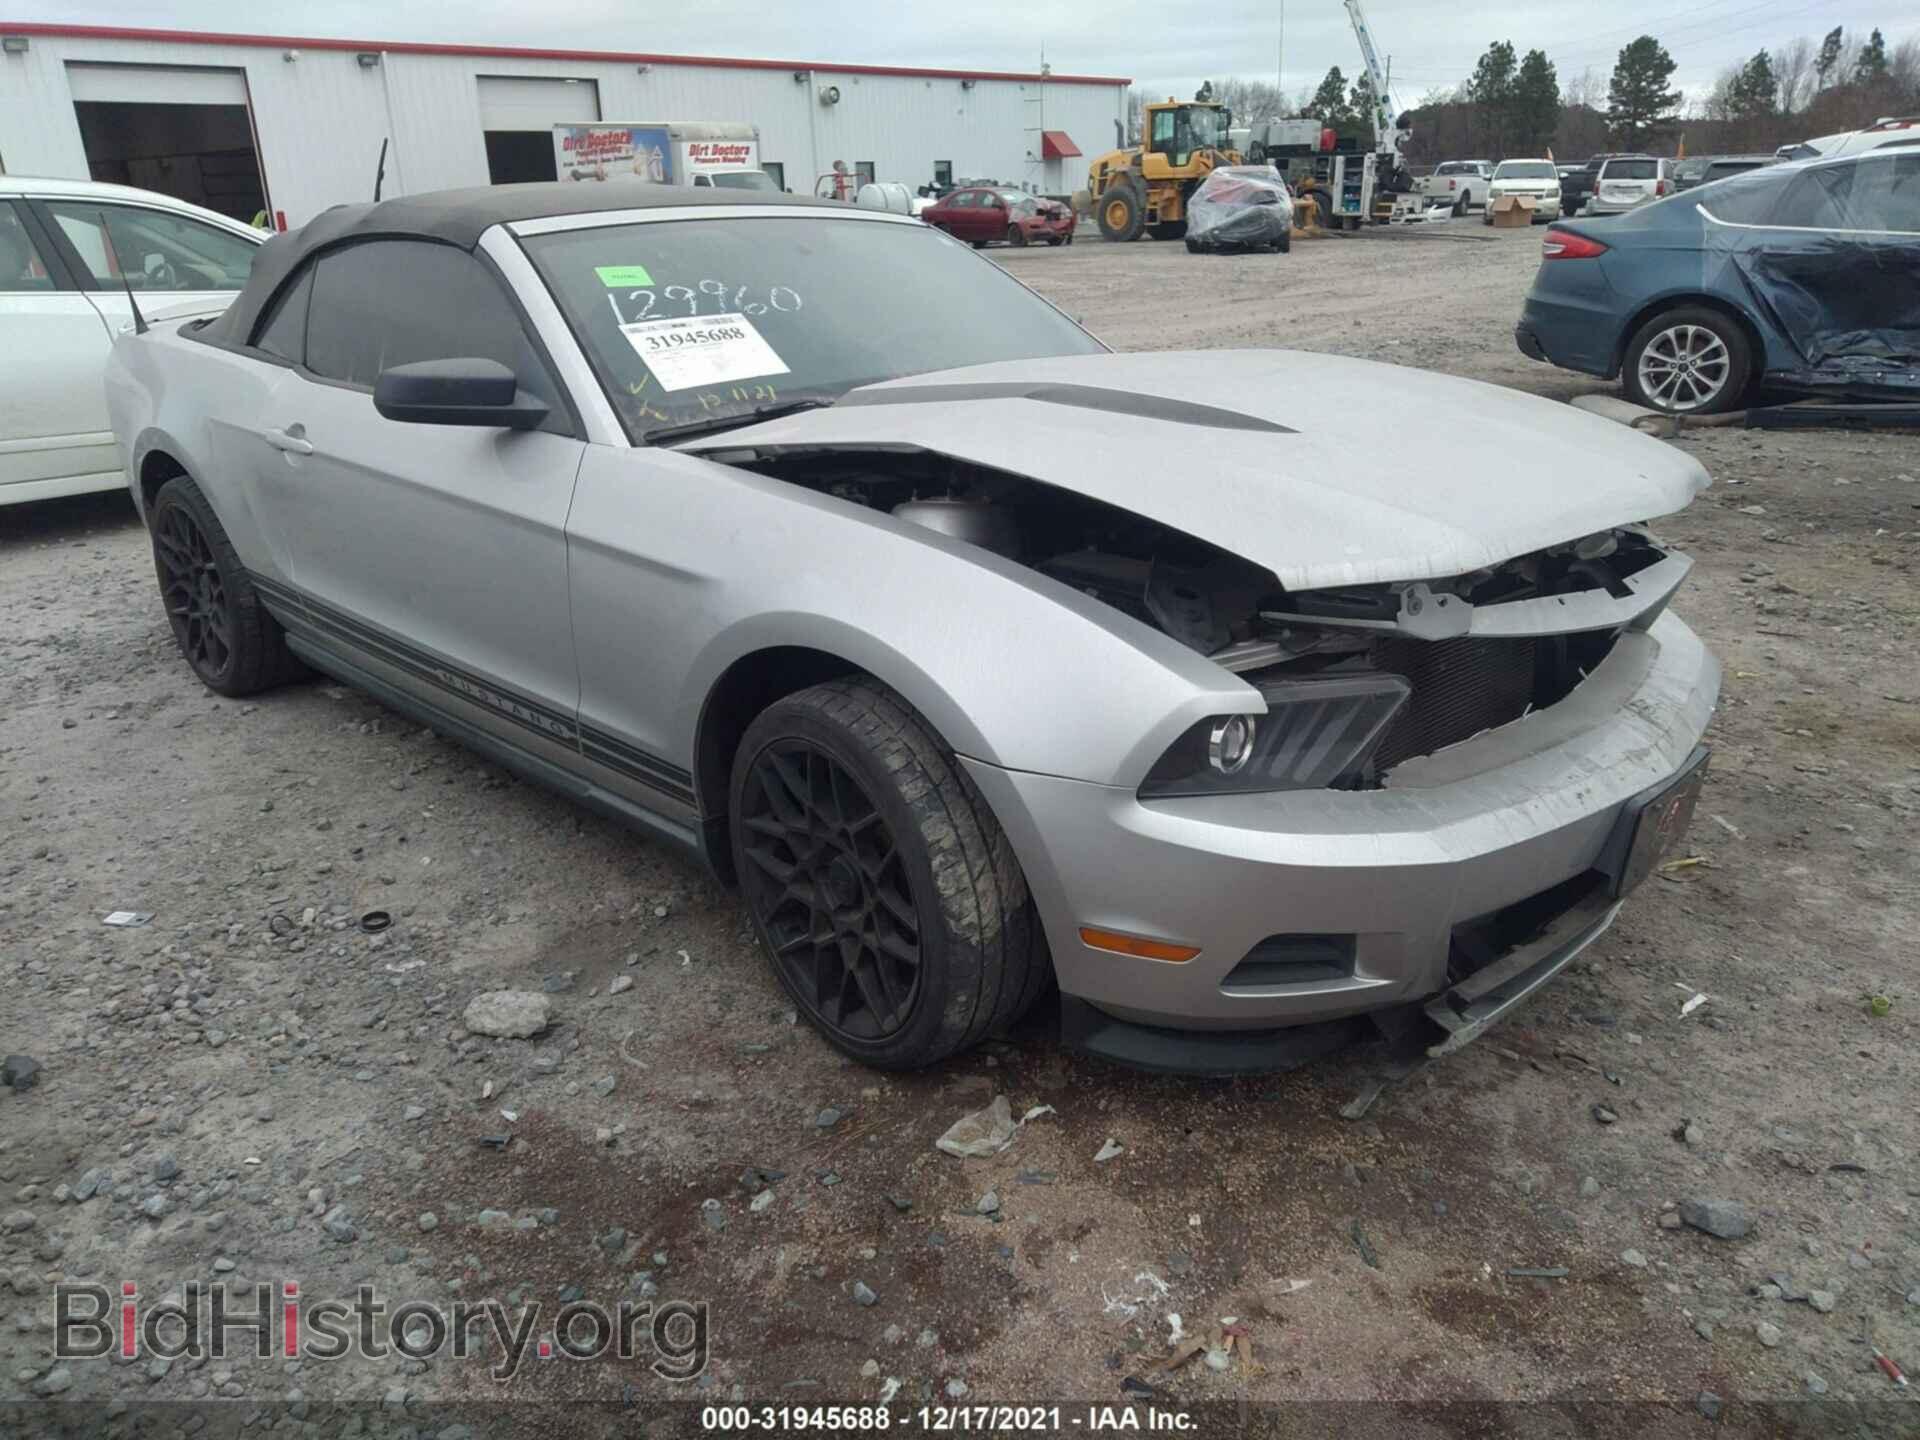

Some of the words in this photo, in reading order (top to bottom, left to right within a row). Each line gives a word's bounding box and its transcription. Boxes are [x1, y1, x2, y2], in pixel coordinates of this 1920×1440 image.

[587, 131, 632, 148] Doctors
[688, 144, 709, 156] Dirt
[712, 144, 750, 156] Doctors
[645, 326, 745, 350] 31945688
